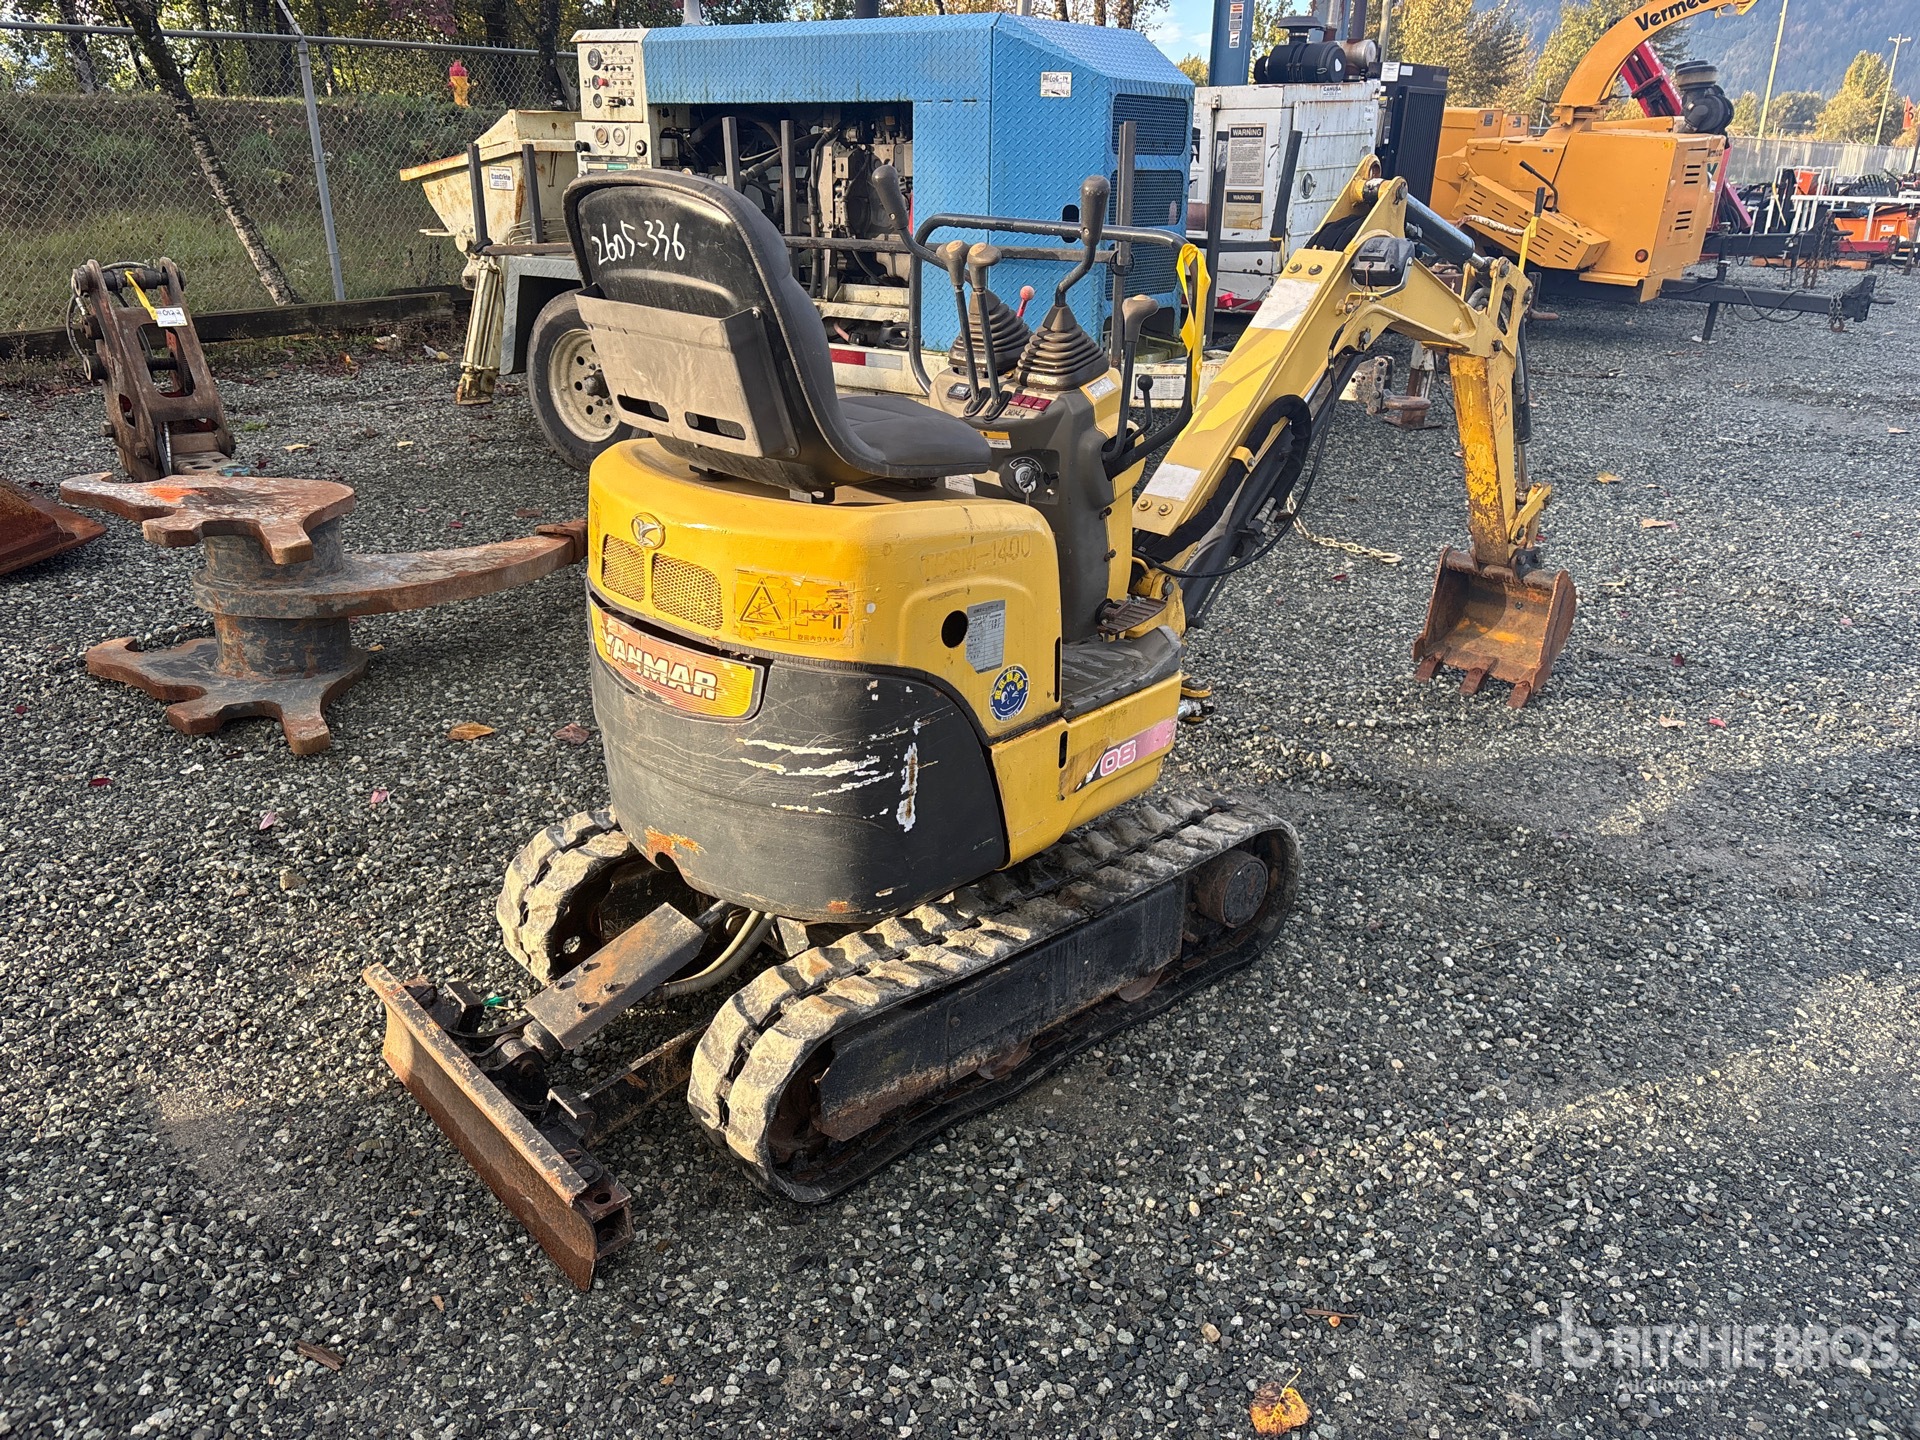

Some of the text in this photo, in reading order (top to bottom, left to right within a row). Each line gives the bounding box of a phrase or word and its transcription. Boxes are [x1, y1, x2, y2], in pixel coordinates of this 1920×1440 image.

[1635, 0, 1709, 31] Verme
[1232, 128, 1262, 136] WARNING
[591, 220, 685, 265] 2605-336
[602, 632, 718, 701] YANMAR
[1100, 740, 1136, 776] 08
